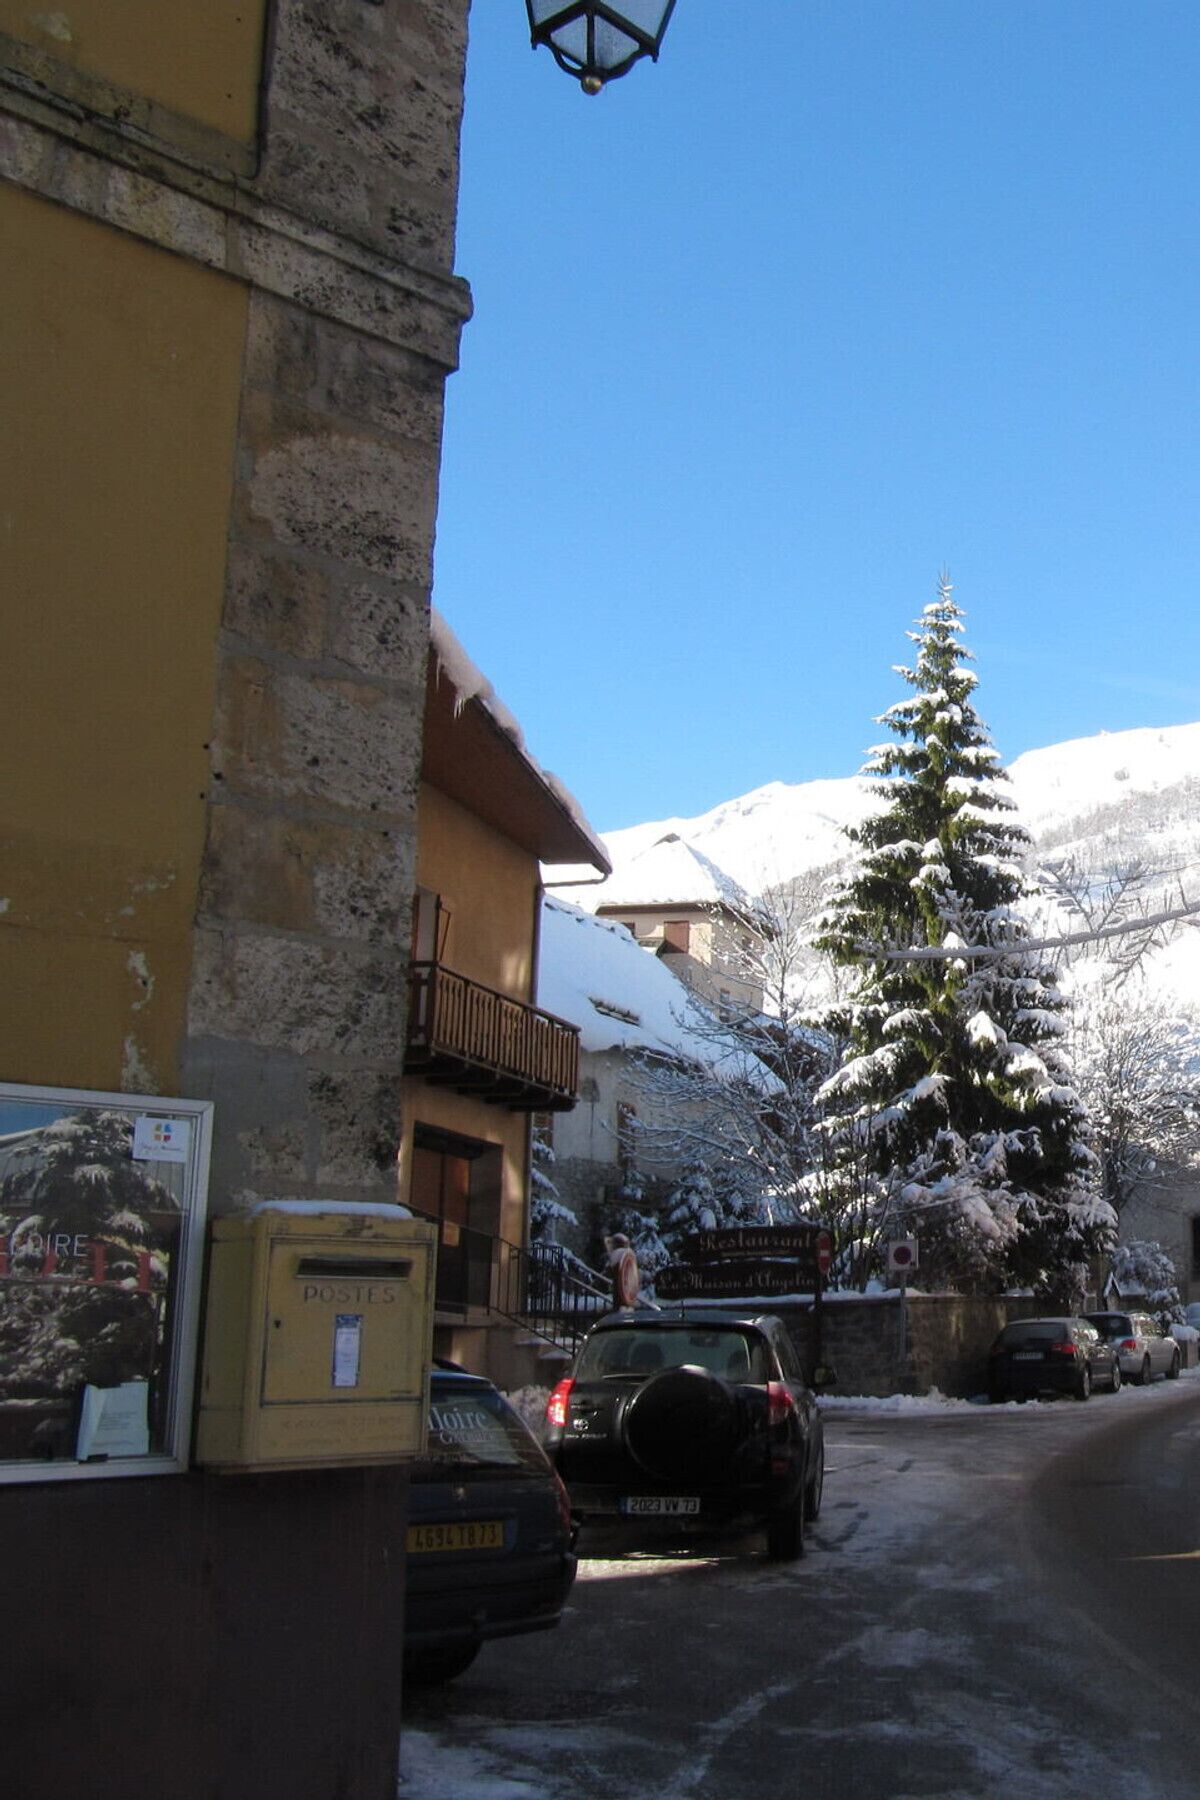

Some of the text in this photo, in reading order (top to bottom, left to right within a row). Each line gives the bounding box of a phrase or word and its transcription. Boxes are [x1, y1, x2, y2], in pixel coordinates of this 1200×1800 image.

[0, 1232, 89, 1257] LOIRE
[699, 1231, 811, 1251] Restaurant
[686, 1271, 742, 1290] Maison
[303, 1285, 396, 1304] POSTES
[427, 1406, 489, 1431] lloire
[631, 1498, 661, 1512] 2023
[683, 1498, 697, 1512] 73
